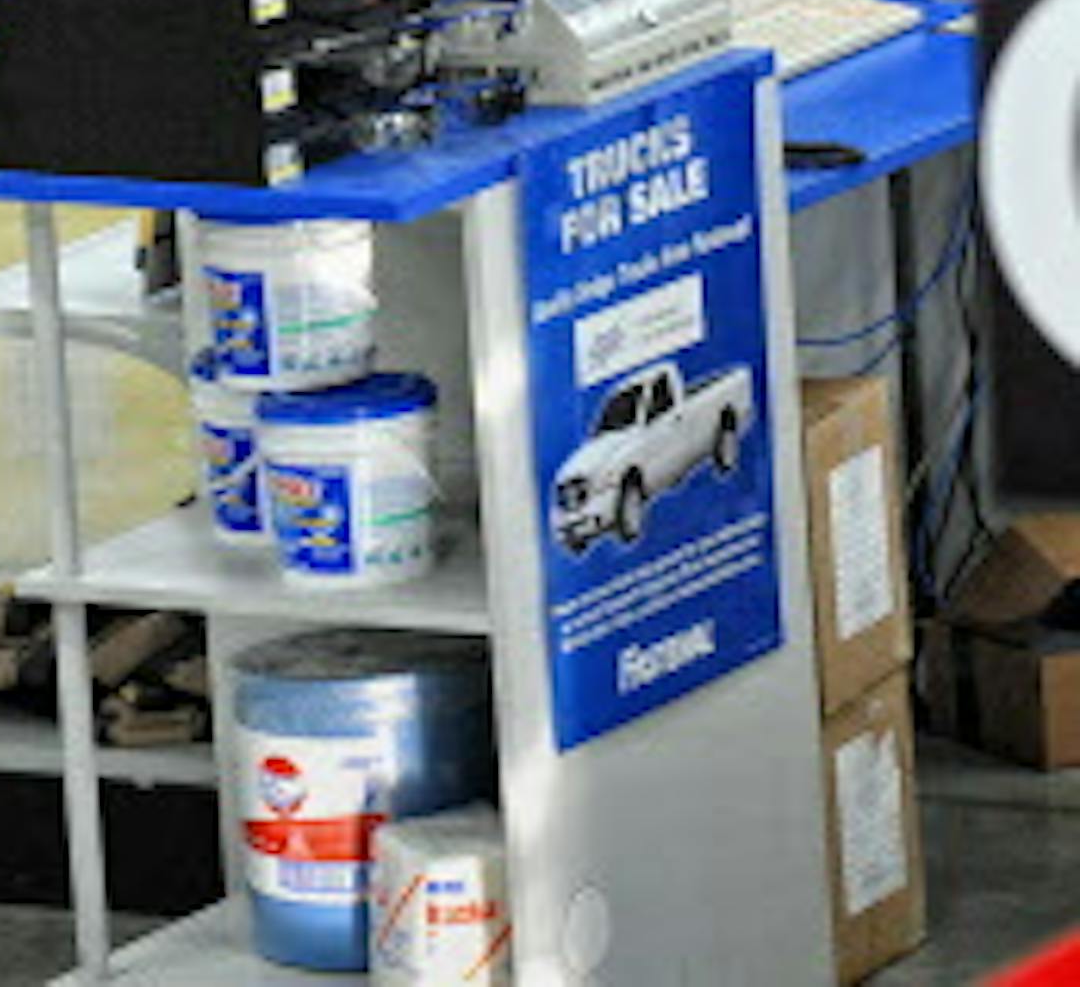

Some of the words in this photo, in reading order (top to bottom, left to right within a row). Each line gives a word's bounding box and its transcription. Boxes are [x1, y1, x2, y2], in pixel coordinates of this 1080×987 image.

[567, 114, 691, 198] TRUCKS
[560, 193, 621, 254] FOR
[628, 156, 710, 224] SALE
